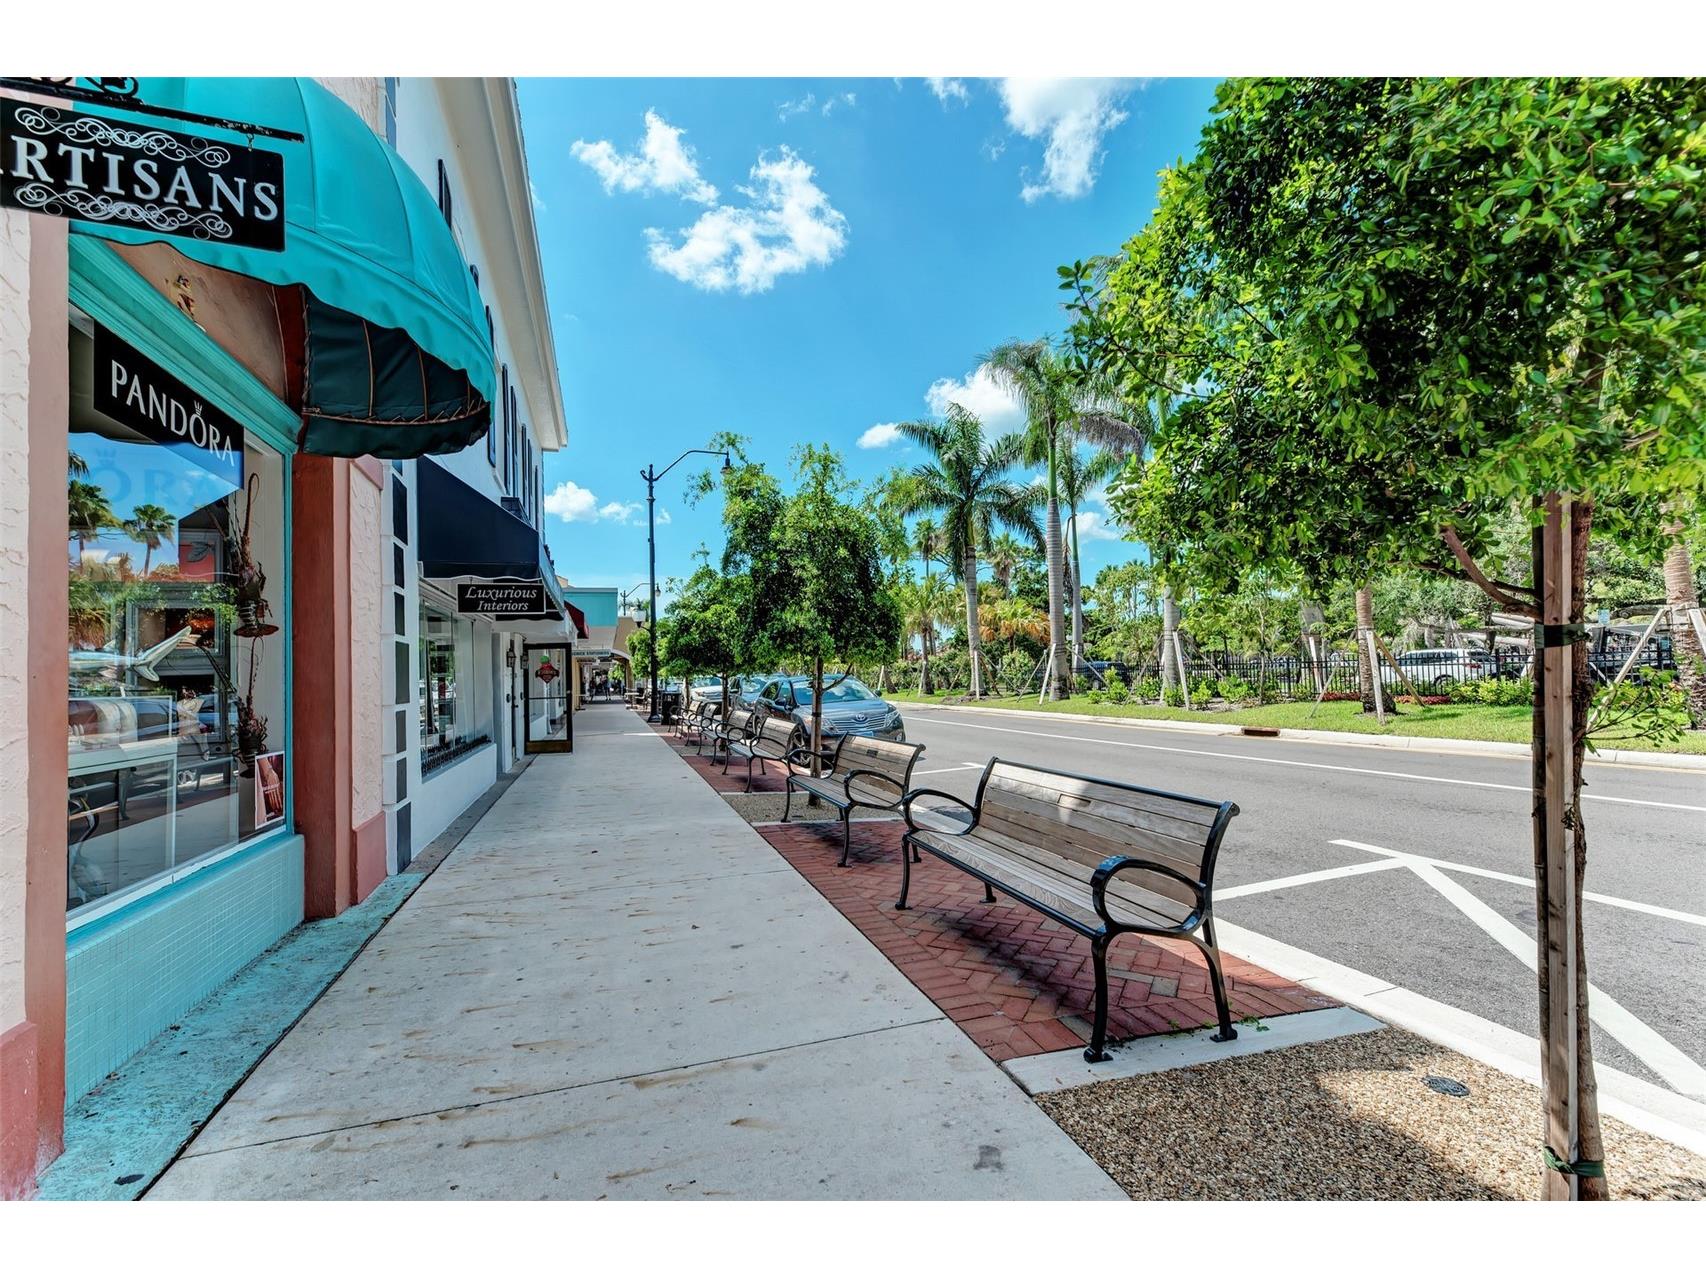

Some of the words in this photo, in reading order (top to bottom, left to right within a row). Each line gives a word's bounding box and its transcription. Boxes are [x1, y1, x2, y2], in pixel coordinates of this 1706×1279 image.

[0, 135, 278, 221] RTISANS
[111, 359, 235, 467] PANDORA
[465, 586, 538, 600] Luxurious
[477, 600, 529, 611] Interiors
